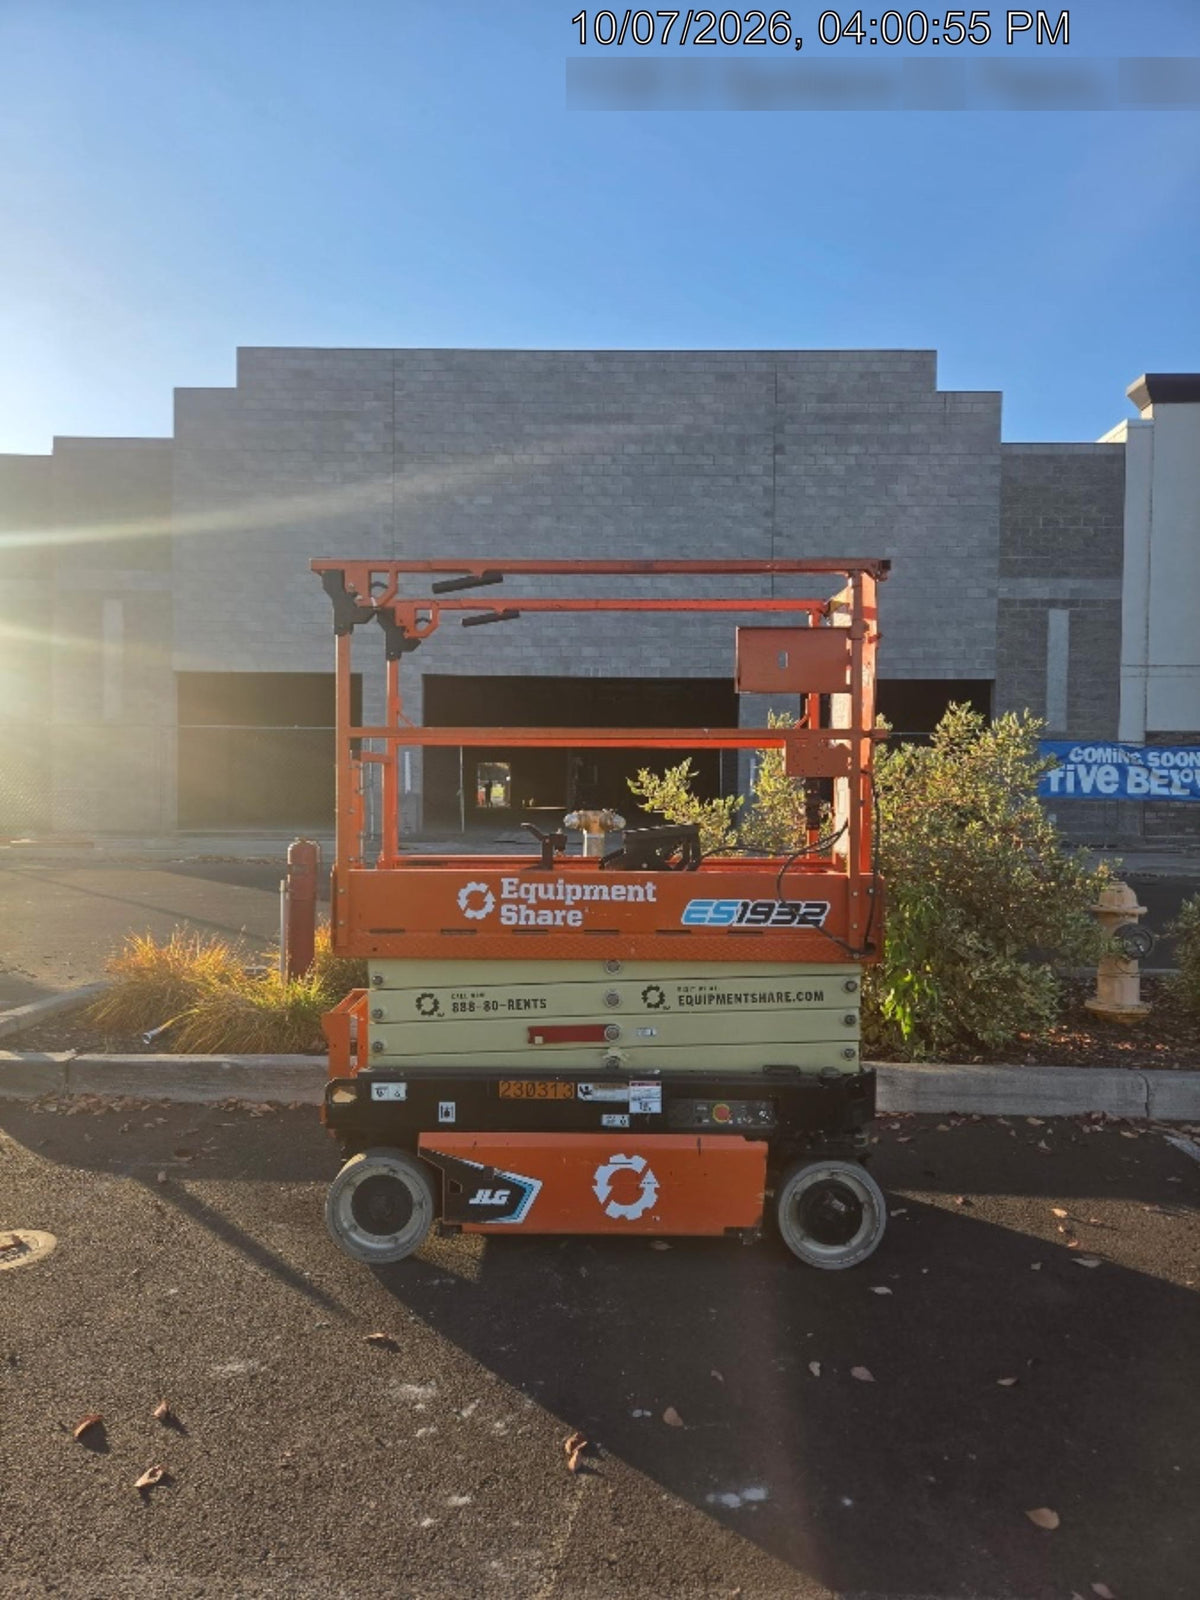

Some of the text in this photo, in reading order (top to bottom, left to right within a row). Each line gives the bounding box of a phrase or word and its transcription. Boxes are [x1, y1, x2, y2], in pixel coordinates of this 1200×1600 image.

[501, 878, 657, 905] Equipment
[501, 904, 582, 926] Share
[681, 900, 831, 928] ES1932
[678, 990, 824, 1007] EQUIPMENTSHARE.COM
[501, 1081, 573, 1098] 230313
[468, 1188, 511, 1205] JLG
